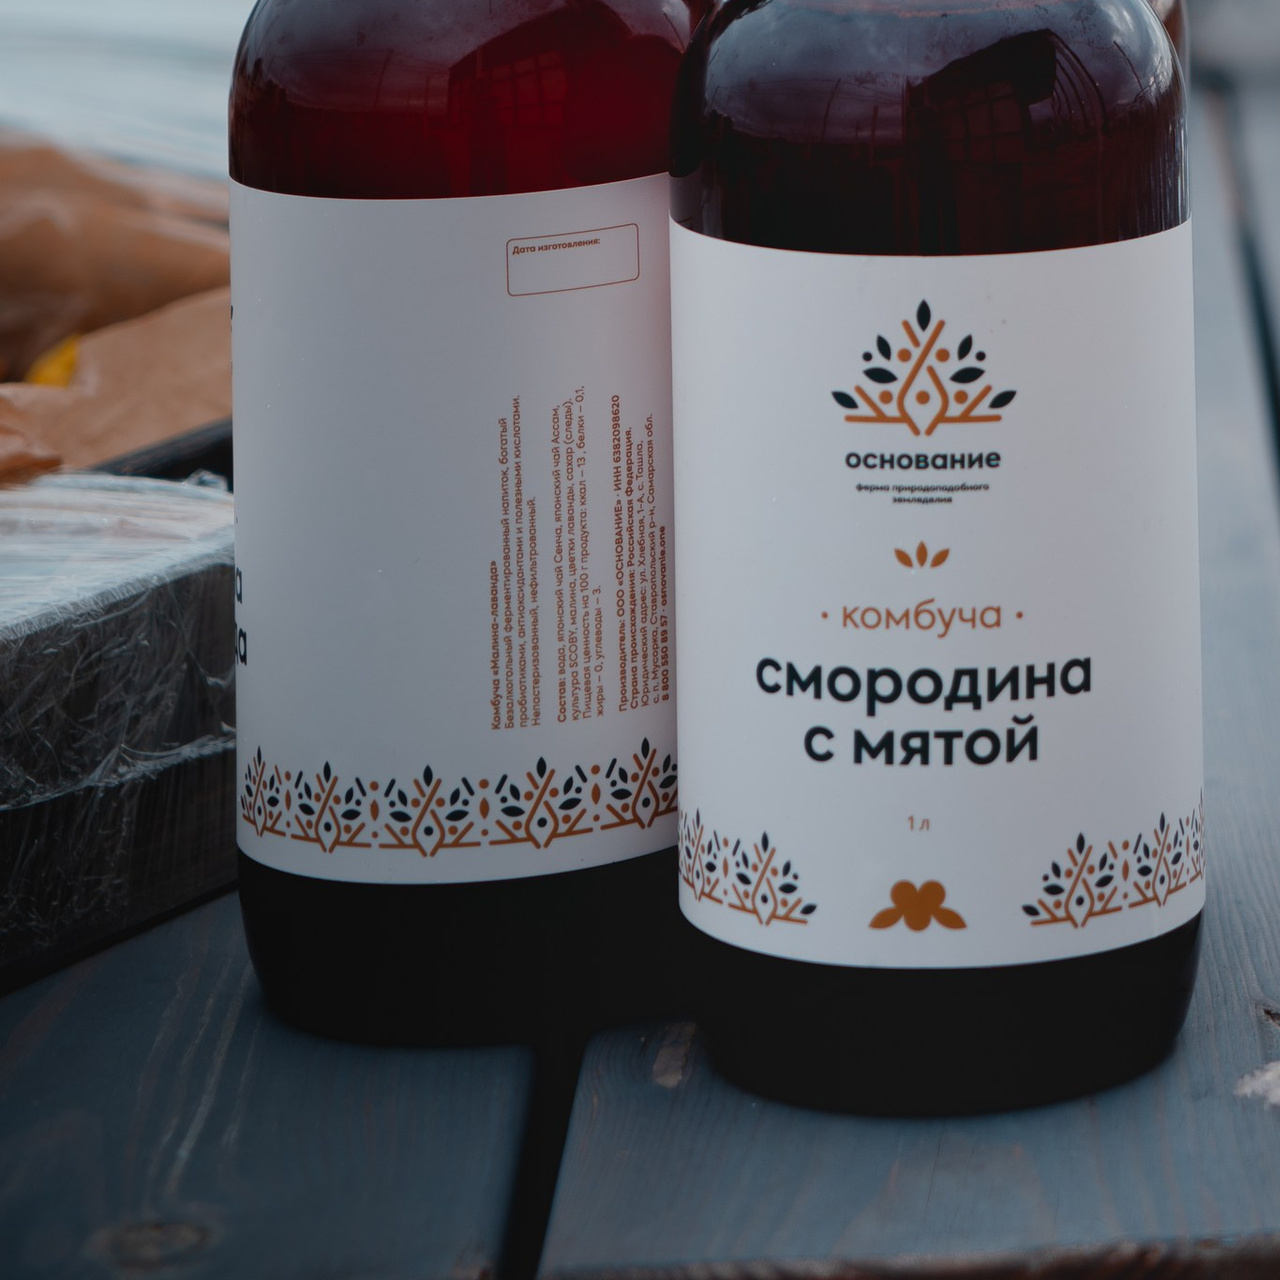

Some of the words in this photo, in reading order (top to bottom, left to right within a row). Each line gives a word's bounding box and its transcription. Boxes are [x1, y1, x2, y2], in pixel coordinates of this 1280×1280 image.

[512, 245, 536, 256] Дата
[538, 238, 600, 251] изготовления:
[498, 417, 508, 465] богатый
[512, 395, 522, 459] кислотами.
[551, 405, 560, 444] Ассам,
[562, 398, 575, 445] (следы).
[576, 415, 586, 449] белки
[644, 414, 654, 438] обл.
[551, 446, 561, 468] чай
[565, 446, 575, 481] сахар
[576, 456, 586, 468] 13
[613, 465, 622, 492] ИНН
[624, 426, 634, 497] Федерация.
[635, 440, 644, 481] Ташла,
[646, 439, 656, 504] Самарская
[844, 451, 1001, 470] основание
[501, 466, 510, 516] напиток,
[514, 461, 523, 524] полезными
[552, 469, 562, 522] японский
[567, 483, 576, 536] лаванды,
[579, 480, 587, 506] ккал
[580, 508, 590, 564] продукта:
[626, 499, 635, 568] Российская
[636, 515, 646, 567] Хлебная,
[649, 506, 657, 529] р-н,
[526, 496, 539, 603] нефильтрованный.
[553, 524, 563, 564] Сенча,
[568, 538, 578, 577] цветки
[614, 499, 624, 586] «ОСНОВАНИЕ»
[500, 518, 514, 633] ферментированный
[516, 536, 526, 639] антиоксидантами
[554, 565, 564, 587] чай
[579, 572, 589, 593] 100
[640, 568, 648, 585] ул.
[648, 530, 659, 625] Ставропольский
[490, 560, 500, 676] «Малина-лаванда»
[555, 588, 565, 642] японский
[569, 578, 577, 626] малина,
[582, 594, 589, 609] на
[616, 589, 625, 618] ООО
[629, 569, 639, 664] происхождения:
[640, 585, 649, 624] адрес:
[660, 615, 668, 627] 57
[842, 597, 1001, 639] комбуча
[568, 627, 578, 668] SCOBY,
[582, 610, 592, 664] ценность
[594, 607, 605, 661] углеводы
[651, 626, 660, 680] Мусорка,
[660, 630, 668, 644] 89
[660, 646, 669, 667] 550
[504, 635, 514, 729] Безалкогольный
[529, 605, 542, 726] Непастеризованный,
[558, 644, 566, 675] вода,
[618, 619, 628, 712] Производитель:
[639, 626, 651, 707] Юридический
[661, 668, 669, 691] 800
[490, 679, 503, 730] Комбуча
[517, 640, 530, 728] пробиотиками,
[557, 677, 567, 723] Состав:
[571, 670, 581, 721] культура
[580, 666, 593, 719] Пищевая
[596, 685, 606, 717] жиры
[630, 666, 640, 710] Страна
[756, 656, 1092, 717] смородина
[803, 725, 835, 762] с
[853, 713, 1038, 766] мятой
[907, 815, 915, 831] 1
[919, 818, 930, 831] л
